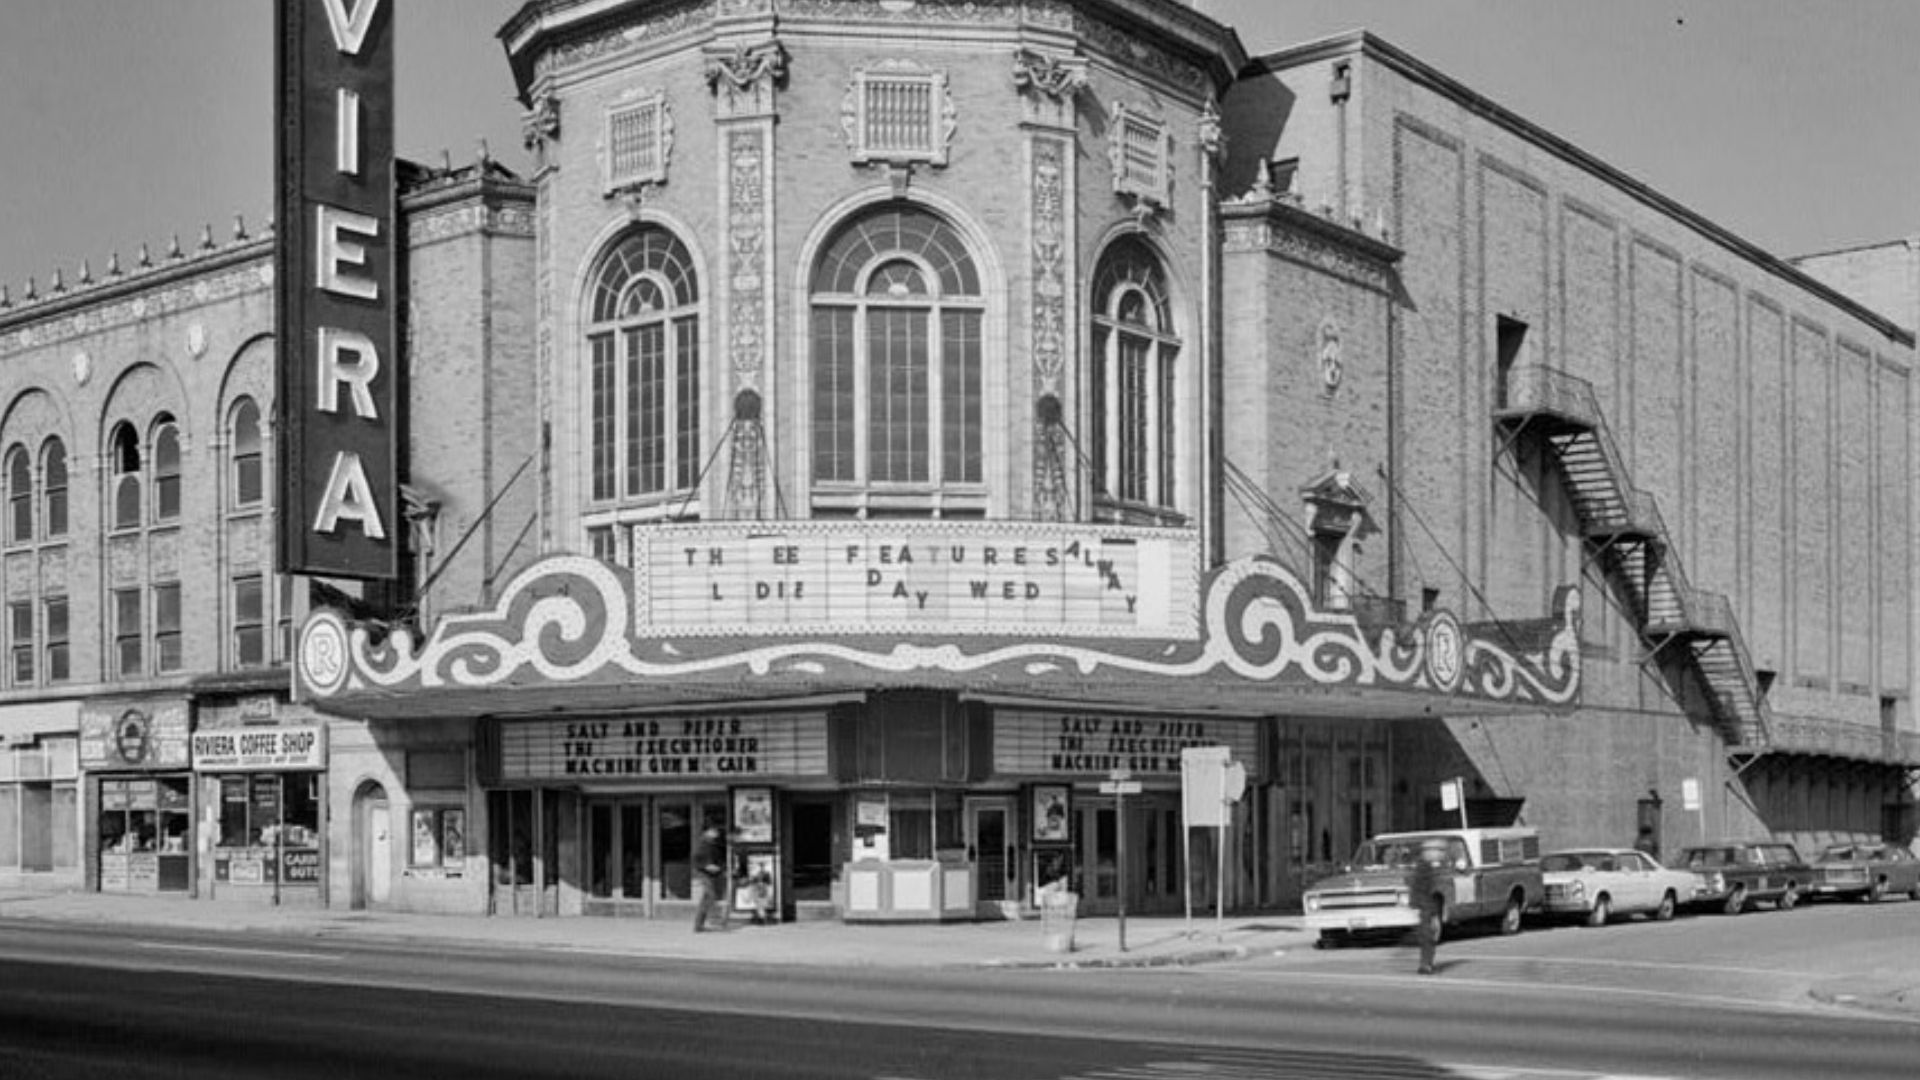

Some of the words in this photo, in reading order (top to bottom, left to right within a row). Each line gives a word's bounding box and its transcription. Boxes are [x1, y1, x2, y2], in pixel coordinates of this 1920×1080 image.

[846, 545, 1059, 566] FEATURES
[867, 569, 929, 610] DAY
[969, 581, 1040, 600] WED
[567, 722, 609, 738] SALT
[623, 721, 660, 737] AND
[1061, 717, 1101, 733] SALT
[1112, 719, 1143, 735] AND
[195, 735, 236, 755] RIVIERA
[240, 733, 278, 755] COFFEE
[281, 731, 315, 753] SHOP
[564, 741, 593, 756] THE
[636, 738, 759, 755] EXECUTIONER
[1059, 735, 1084, 751] THE
[1109, 738, 1217, 752] EXECUTIO
[565, 758, 642, 774] MACHINE
[649, 757, 682, 773] GUN
[717, 757, 757, 772] CAIN
[1052, 754, 1120, 771] MACHINE
[1129, 756, 1159, 771] GUN
